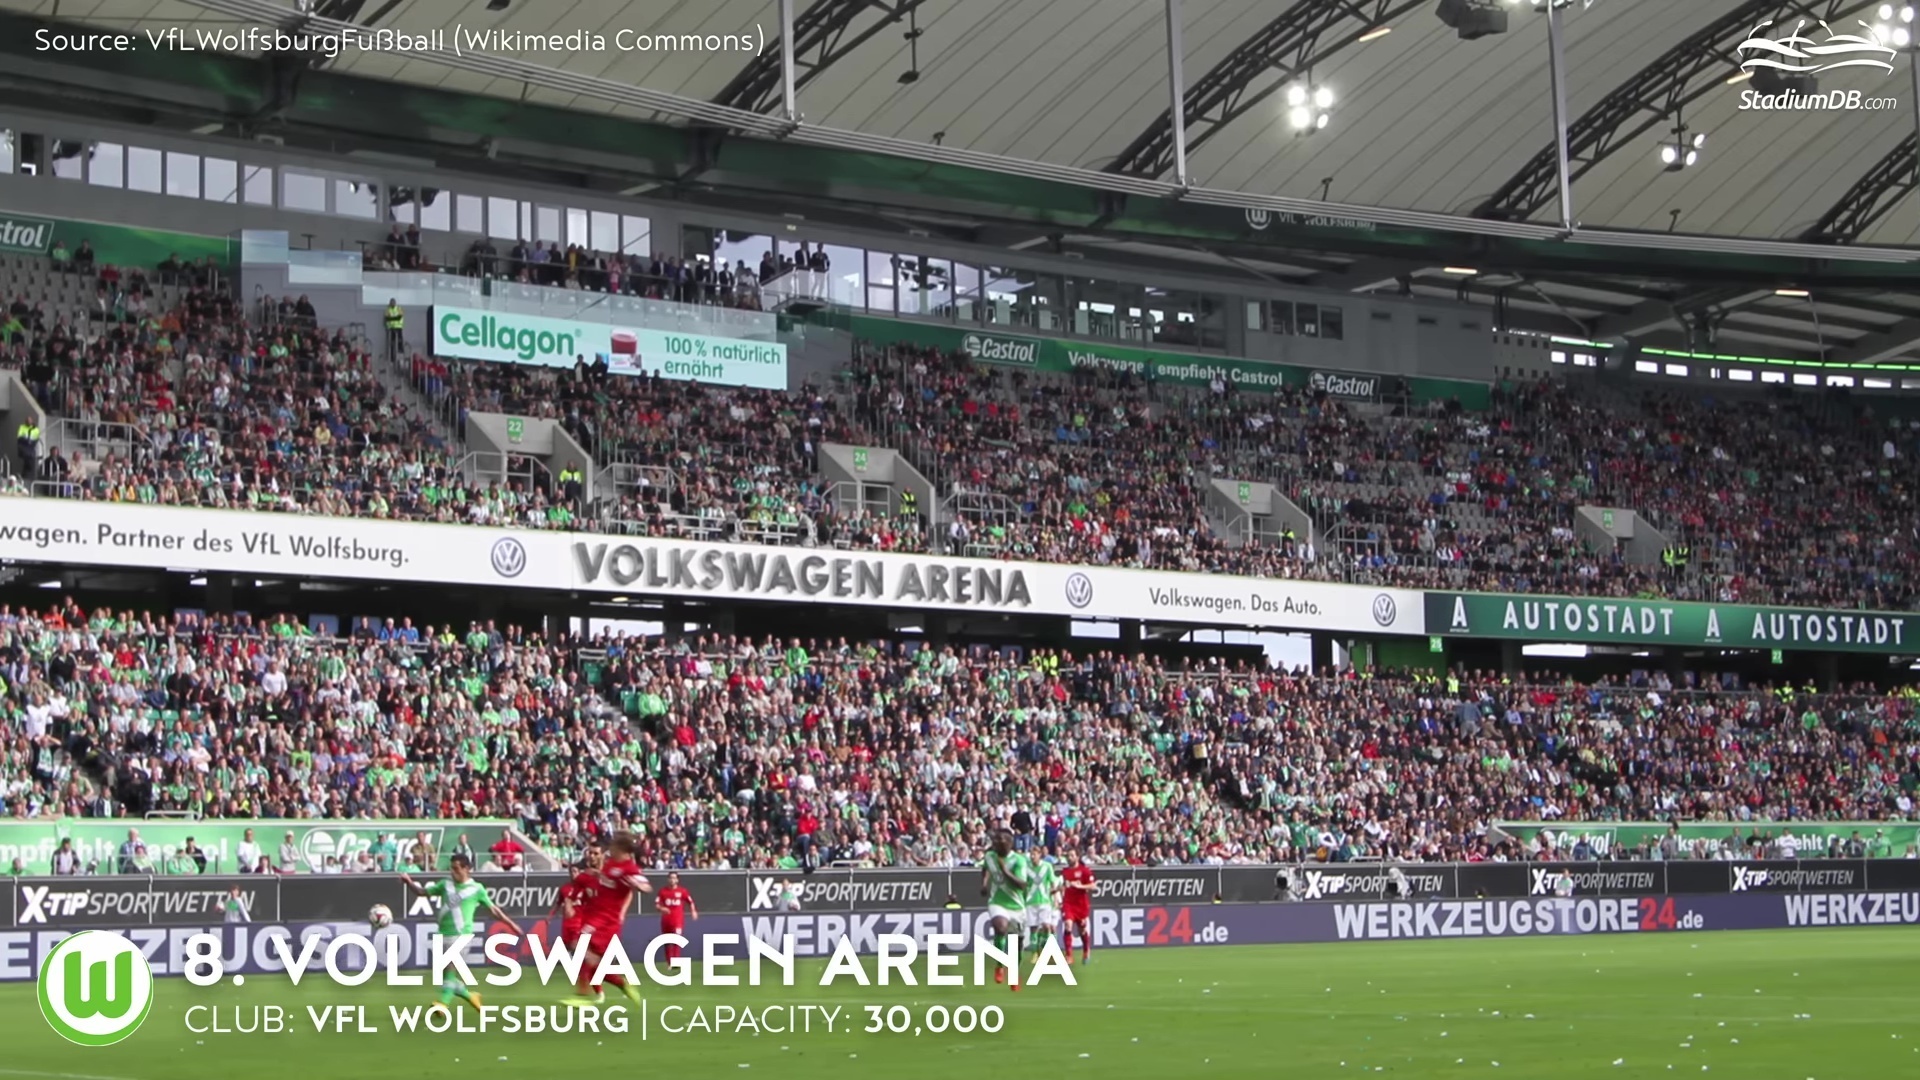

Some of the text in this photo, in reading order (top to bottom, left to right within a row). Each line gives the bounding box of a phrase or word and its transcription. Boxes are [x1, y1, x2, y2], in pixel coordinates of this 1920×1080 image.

[440, 313, 575, 361] Cellagon
[712, 343, 781, 365] natürlich
[982, 338, 1034, 362] Castrol
[664, 360, 724, 379] ernährt
[1231, 368, 1283, 386] Castrol
[1326, 375, 1375, 397] Castrol
[509, 421, 521, 432] 22
[98, 523, 185, 550] Partner
[193, 528, 233, 553] des
[242, 532, 281, 555] VfL
[289, 535, 410, 567] Wolfsburg.
[572, 541, 1033, 606] VOLKSWAGEN ARENA
[1149, 587, 1322, 616] Volkswagen. Das Auto.
[1503, 601, 1673, 635] AUTOSTADT
[1752, 612, 1904, 645] AUTOSTADT
[1092, 878, 1205, 898] SPORTWETTEN
[1570, 873, 1655, 889] PORTWETTEN
[1767, 870, 1854, 887] SPORTWETTEN
[803, 882, 932, 903] SPORTWETTEN
[1333, 897, 1704, 939] WERKZEUGSTORE24.de
[1784, 892, 1919, 925] WERKZEU
